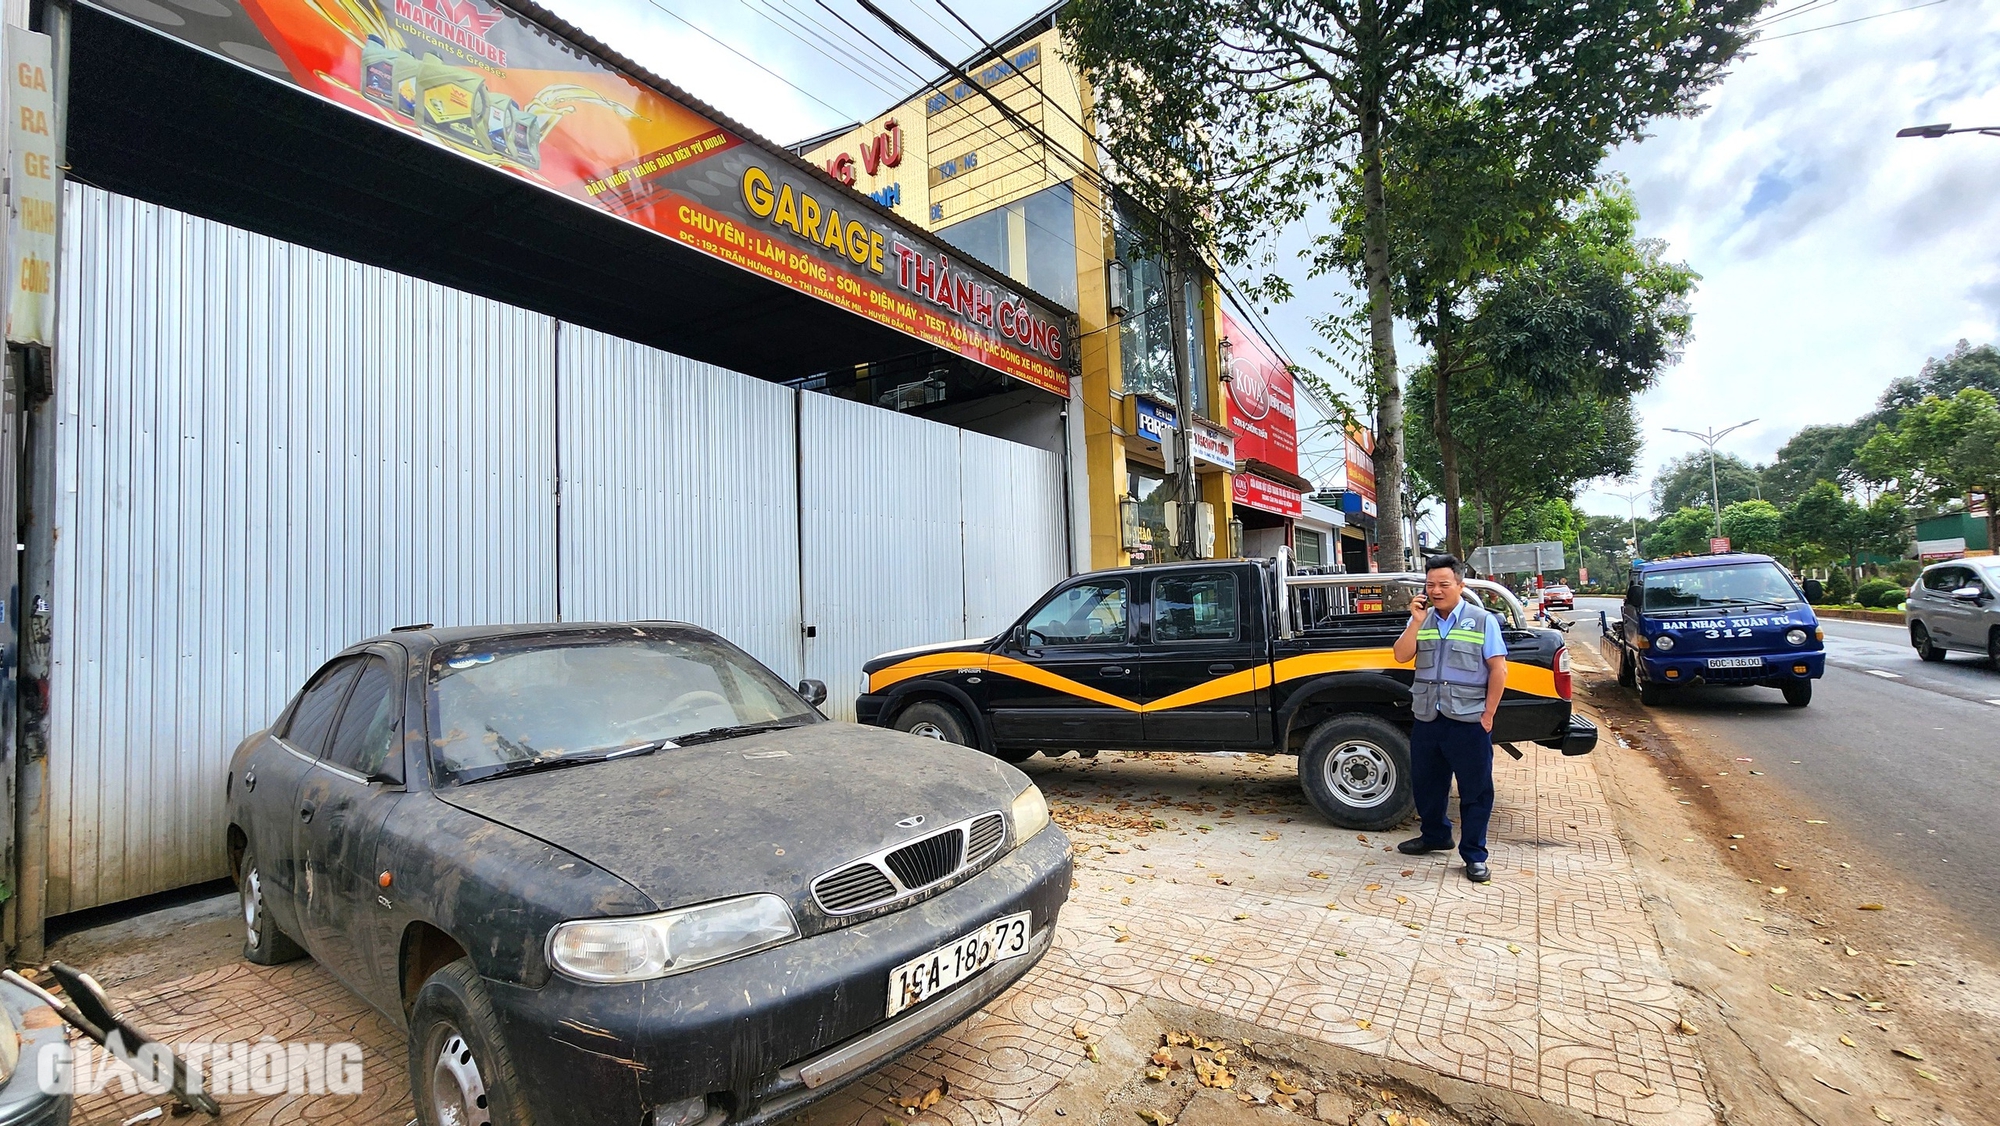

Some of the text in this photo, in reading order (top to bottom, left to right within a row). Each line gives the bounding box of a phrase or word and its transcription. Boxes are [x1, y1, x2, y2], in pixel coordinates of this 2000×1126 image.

[394, 0, 507, 68] MAKINALUBE
[395, 18, 507, 79] Lubricants & Greases
[18, 62, 48, 93] GA
[20, 105, 49, 137] RA
[24, 151, 51, 180] GE
[631, 162, 658, 178] HÀNG
[702, 133, 727, 150] DUBAI
[860, 117, 901, 176] VŨ
[679, 230, 694, 243] ĐC
[702, 240, 718, 253] 192
[747, 259, 772, 276] HƯNG
[774, 270, 793, 284] ĐẠO
[799, 280, 812, 293] THỊ
[813, 287, 834, 301] TRẤN
[851, 302, 863, 313] MIL
[868, 309, 891, 324] HUYỆN
[905, 324, 915, 334] MIL
[742, 165, 1062, 360] GARAGE THÀNH CÔNG
[678, 206, 745, 248] CHUYÊN
[756, 239, 786, 265] LÀM
[789, 254, 827, 282] ĐỒNG
[836, 275, 861, 297] SƠN
[870, 290, 895, 312] ĐIỆN
[897, 301, 918, 320] MÁY
[924, 313, 949, 337] TEST,
[950, 322, 968, 344] XOÁ
[969, 331, 982, 350] LỖI
[984, 339, 999, 356] CÁC
[1001, 347, 1020, 365] DÒNG
[1021, 356, 1030, 369] XE
[1031, 361, 1043, 375] HƠI
[1056, 371, 1067, 385] MỚI
[1236, 368, 1264, 405] KOVA
[1663, 622, 1688, 630] BAN
[1691, 619, 1726, 630] NHẠC
[1732, 617, 1769, 628] XUÂN
[1705, 628, 1753, 639] 312
